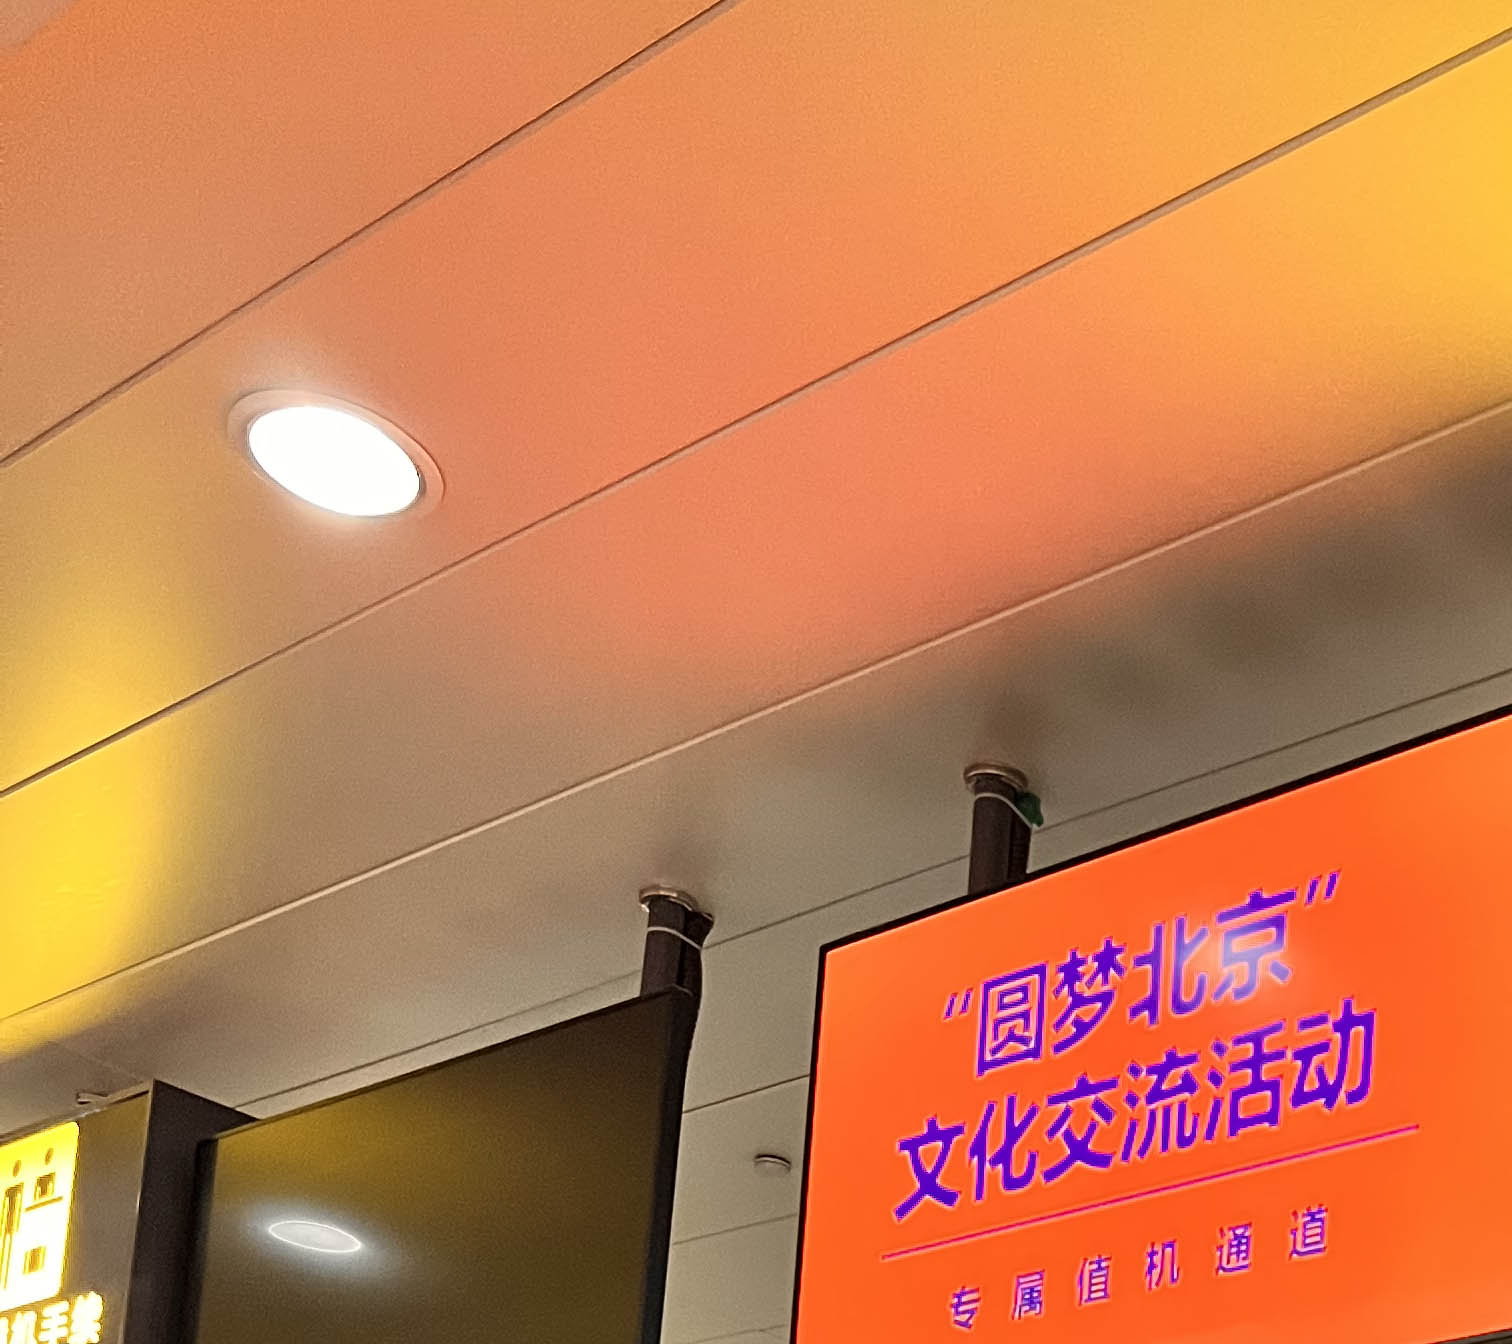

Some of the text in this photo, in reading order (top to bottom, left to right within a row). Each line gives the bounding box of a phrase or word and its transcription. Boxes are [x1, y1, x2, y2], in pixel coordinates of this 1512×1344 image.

[892, 995, 1377, 1223] 文化交流活动
[949, 1204, 1330, 1332] 专属值机通道
